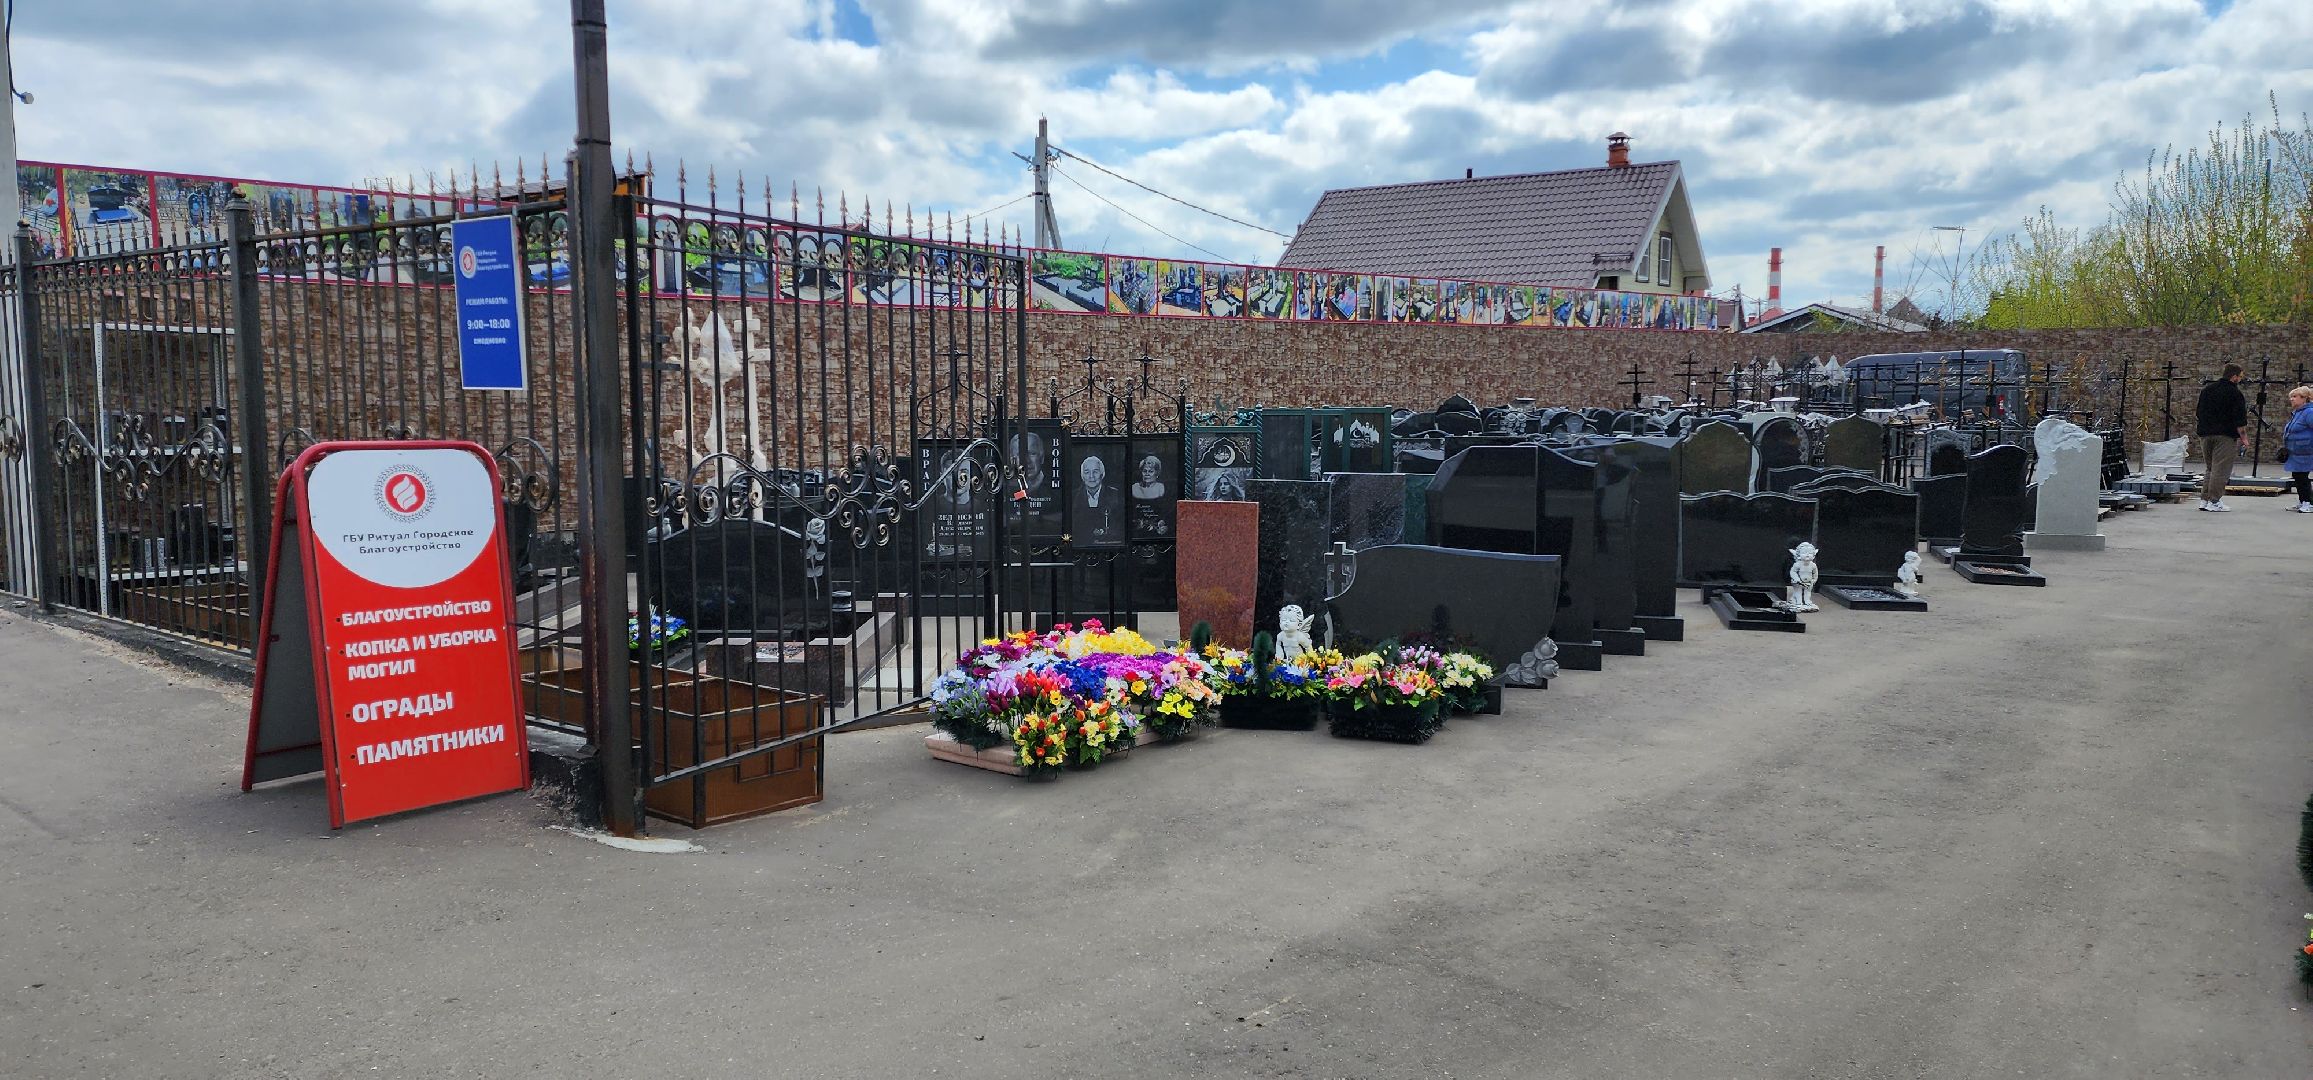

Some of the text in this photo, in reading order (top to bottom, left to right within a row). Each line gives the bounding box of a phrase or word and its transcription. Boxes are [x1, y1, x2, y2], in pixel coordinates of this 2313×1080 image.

[342, 529, 474, 543] ГБУ Ритуал Городское
[359, 541, 461, 554] Благоустройство
[341, 600, 491, 626] БЛАГОУСТРОЙСТВО
[345, 628, 497, 658] КОПКА И УБОРКА
[348, 659, 416, 681] МОГИЛ
[351, 691, 454, 723] ОГРАДЫ
[356, 724, 505, 766] ПАМЯТНИКИ
